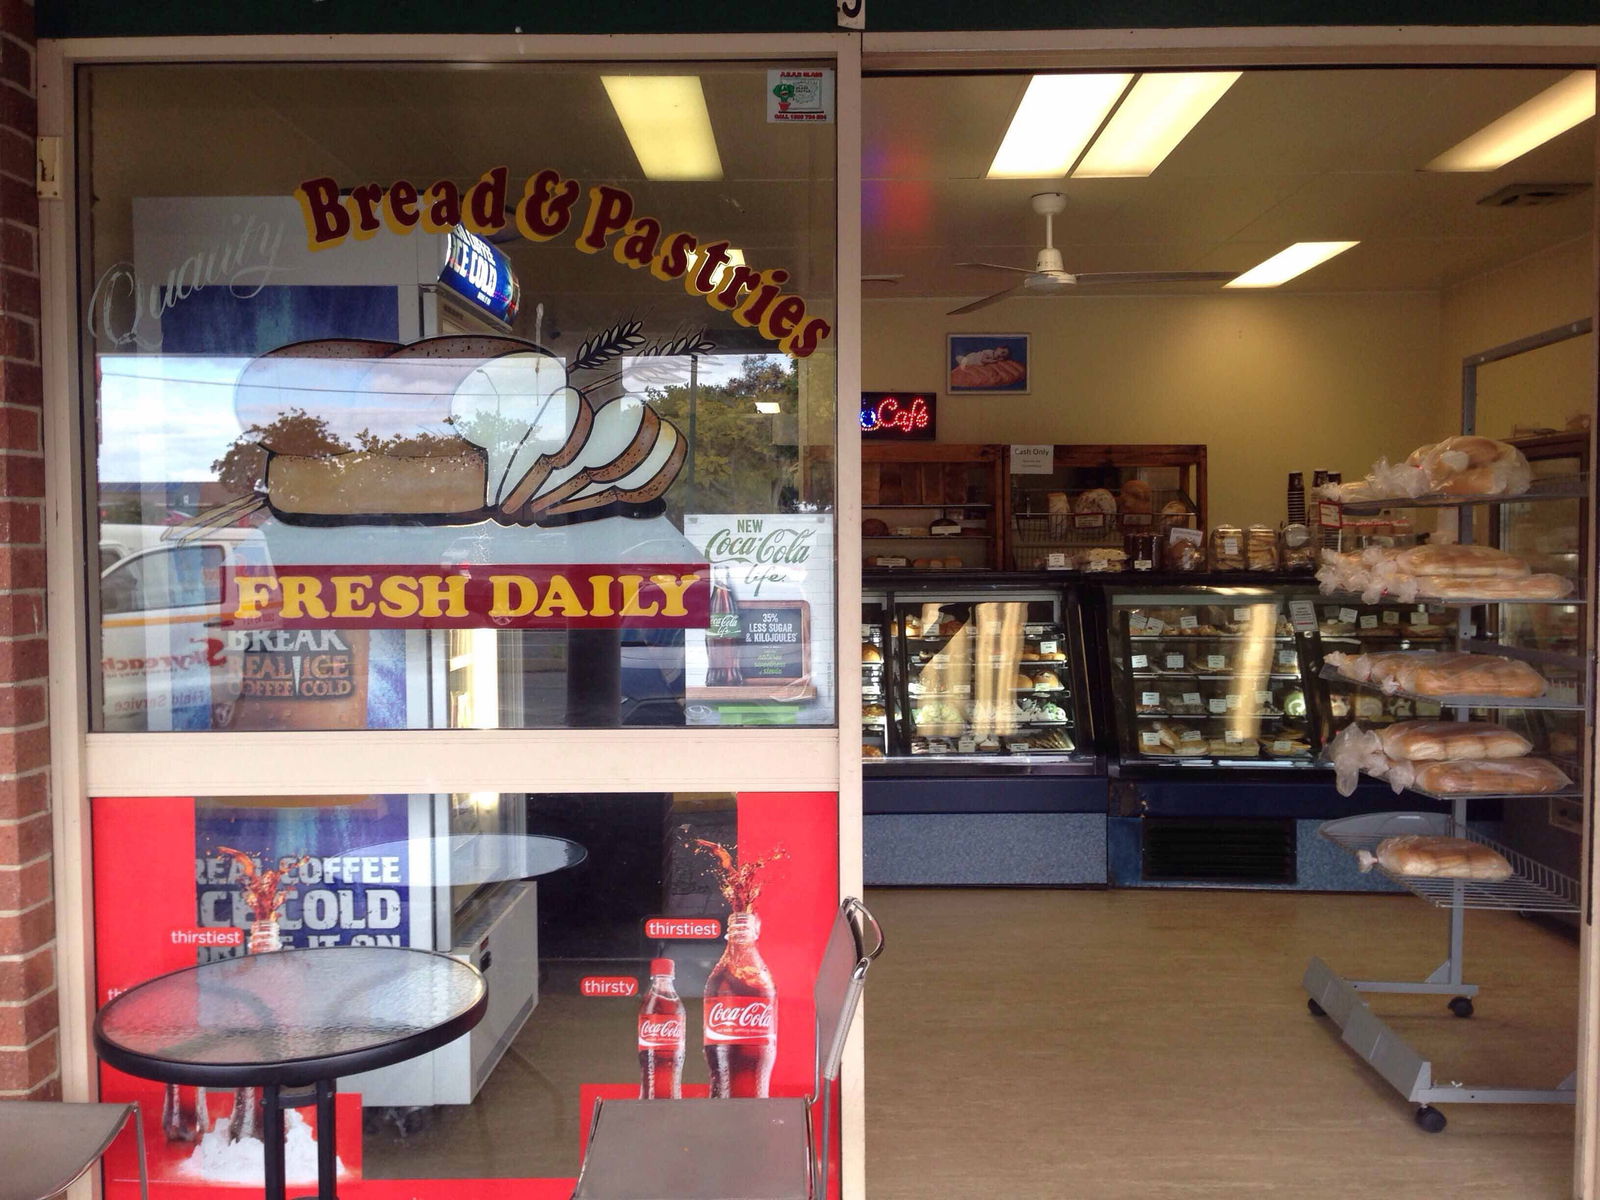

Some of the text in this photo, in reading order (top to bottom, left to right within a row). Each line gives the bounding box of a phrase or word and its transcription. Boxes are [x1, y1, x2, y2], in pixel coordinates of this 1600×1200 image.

[293, 165, 832, 359] Bread & Pastries
[469, 249, 498, 298] COLD
[1014, 447, 1050, 457] Cash Only
[736, 519, 764, 533] NEW
[704, 528, 816, 564] Coca-Cola
[233, 575, 701, 619] FRESH DAILY
[762, 613, 779, 623] 35%
[745, 632, 753, 643] &
[748, 623, 793, 633] LESS SUGAR
[226, 629, 349, 651] BREAK
[302, 653, 349, 679] ICE
[301, 679, 352, 697] COLD
[279, 855, 401, 884] COFFEE
[277, 889, 401, 930] COLD
[170, 930, 241, 946] thirstiest
[648, 921, 718, 937] thirstiest
[584, 980, 636, 996] thirsty
[708, 1002, 774, 1028] Coca-Cola
[640, 1020, 682, 1039] Coca-Cola
